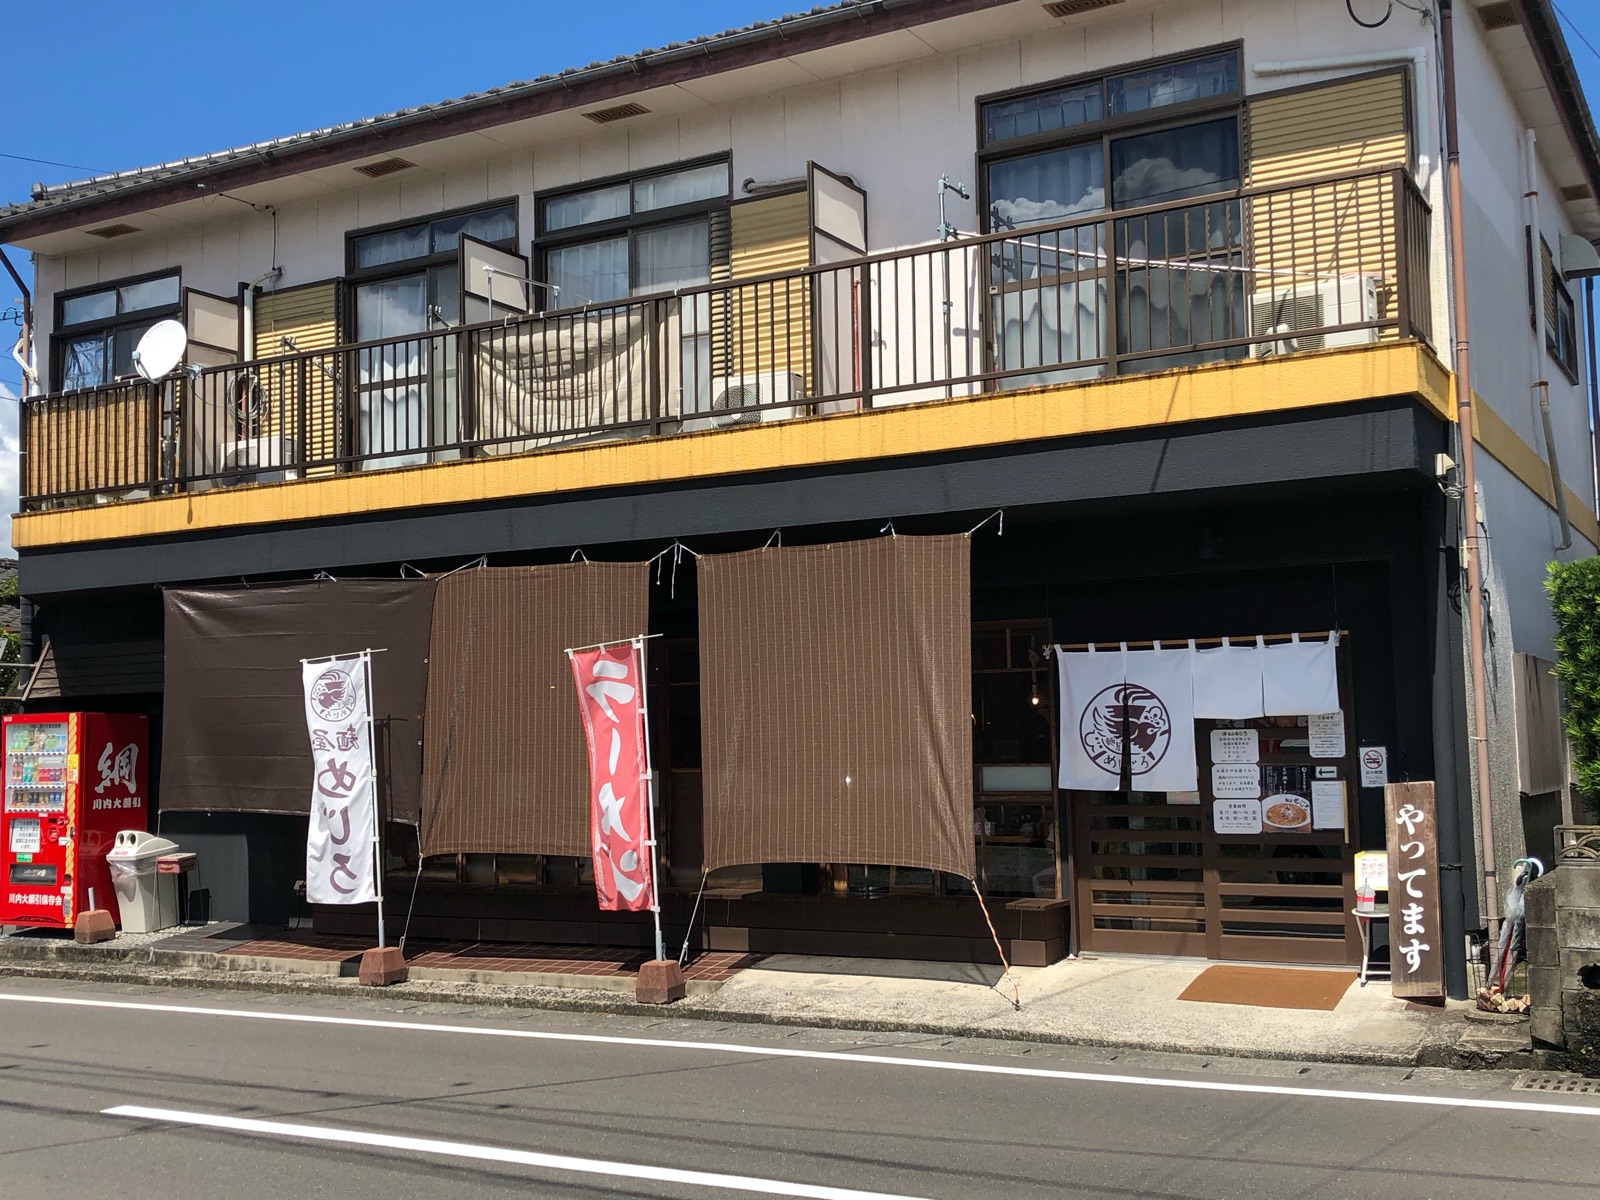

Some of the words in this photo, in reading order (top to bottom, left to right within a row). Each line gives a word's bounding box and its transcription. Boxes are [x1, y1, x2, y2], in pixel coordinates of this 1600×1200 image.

[94, 742, 139, 794] 綱
[92, 797, 141, 810] 川内大綱引
[8, 893, 63, 906] 川内大綱引保存会
[1395, 804, 1430, 974] やってます
